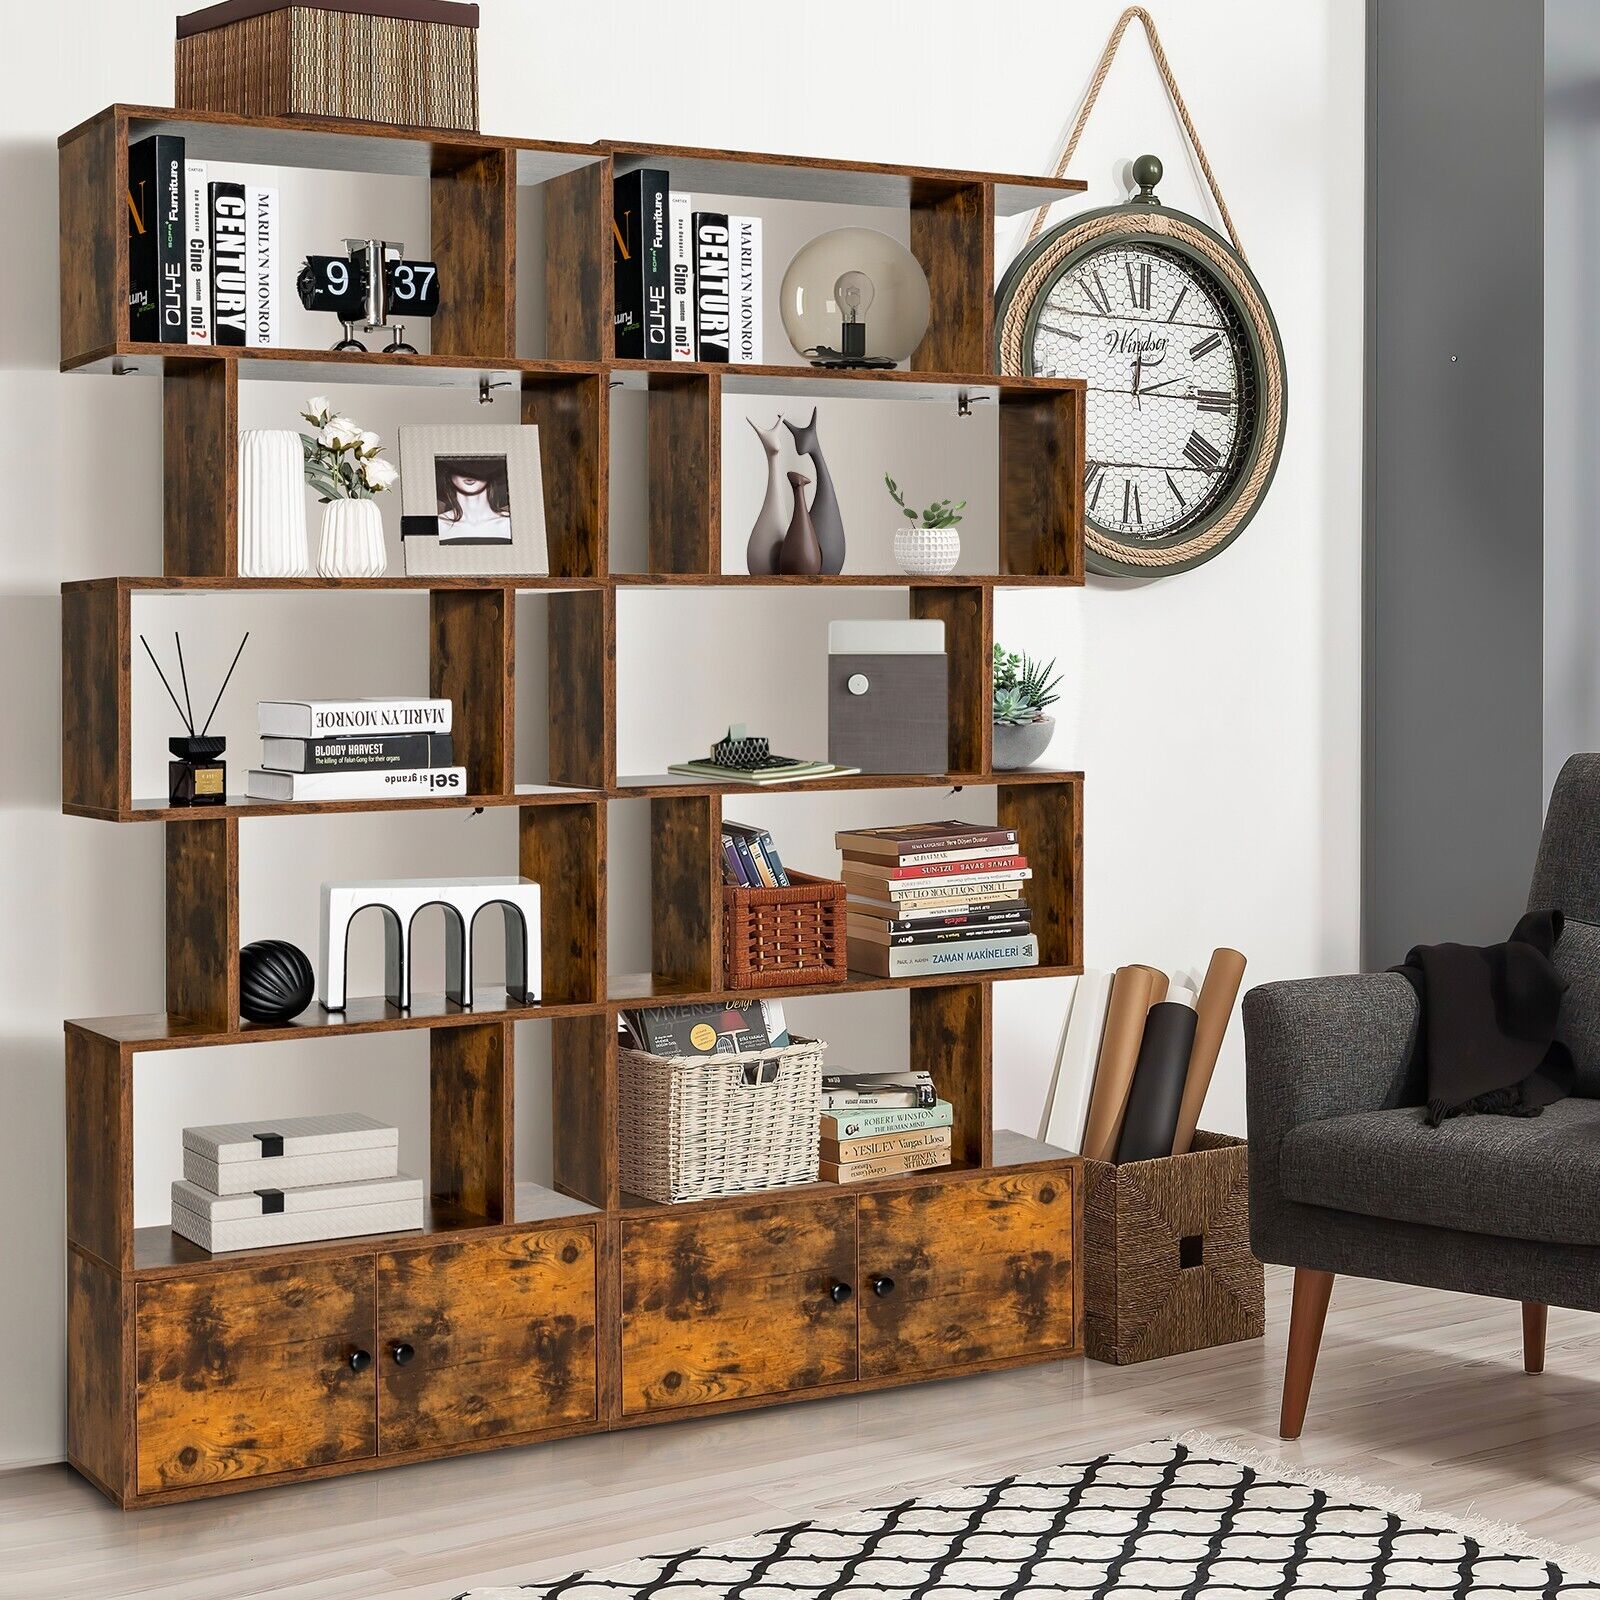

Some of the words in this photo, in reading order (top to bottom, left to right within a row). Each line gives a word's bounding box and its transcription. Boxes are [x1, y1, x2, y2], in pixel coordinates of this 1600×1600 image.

[168, 160, 179, 222] Furniture
[258, 194, 270, 268] MARILYN
[654, 192, 663, 248] Furniture
[190, 238, 204, 272] Cine
[215, 196, 246, 330] CENTURY
[740, 223, 752, 292] MARILYN
[326, 261, 349, 296] 9
[394, 266, 436, 300] 37
[674, 264, 688, 294] Cine
[698, 225, 728, 350] CENTURY
[190, 306, 208, 338] noi?
[258, 272, 270, 344] MONROE
[675, 326, 690, 356] noi?
[740, 296, 752, 360] MONROE
[1104, 328, 1170, 364] Windsor
[316, 710, 378, 728] MONROE
[381, 708, 445, 725] MARILYN
[315, 744, 347, 756] BLOODY
[348, 744, 384, 755] HARVEST
[324, 757, 337, 765] killing
[385, 774, 418, 783] grande
[419, 775, 428, 784] si
[430, 774, 460, 791] sei
[932, 953, 964, 964] ZAMAN
[966, 946, 1019, 960] MAKİNELERİ
[864, 1116, 894, 1126] ROBERT
[897, 1110, 934, 1121] WINSTON
[899, 1138, 922, 1149] Vargas
[925, 1135, 944, 1144] Llosa
